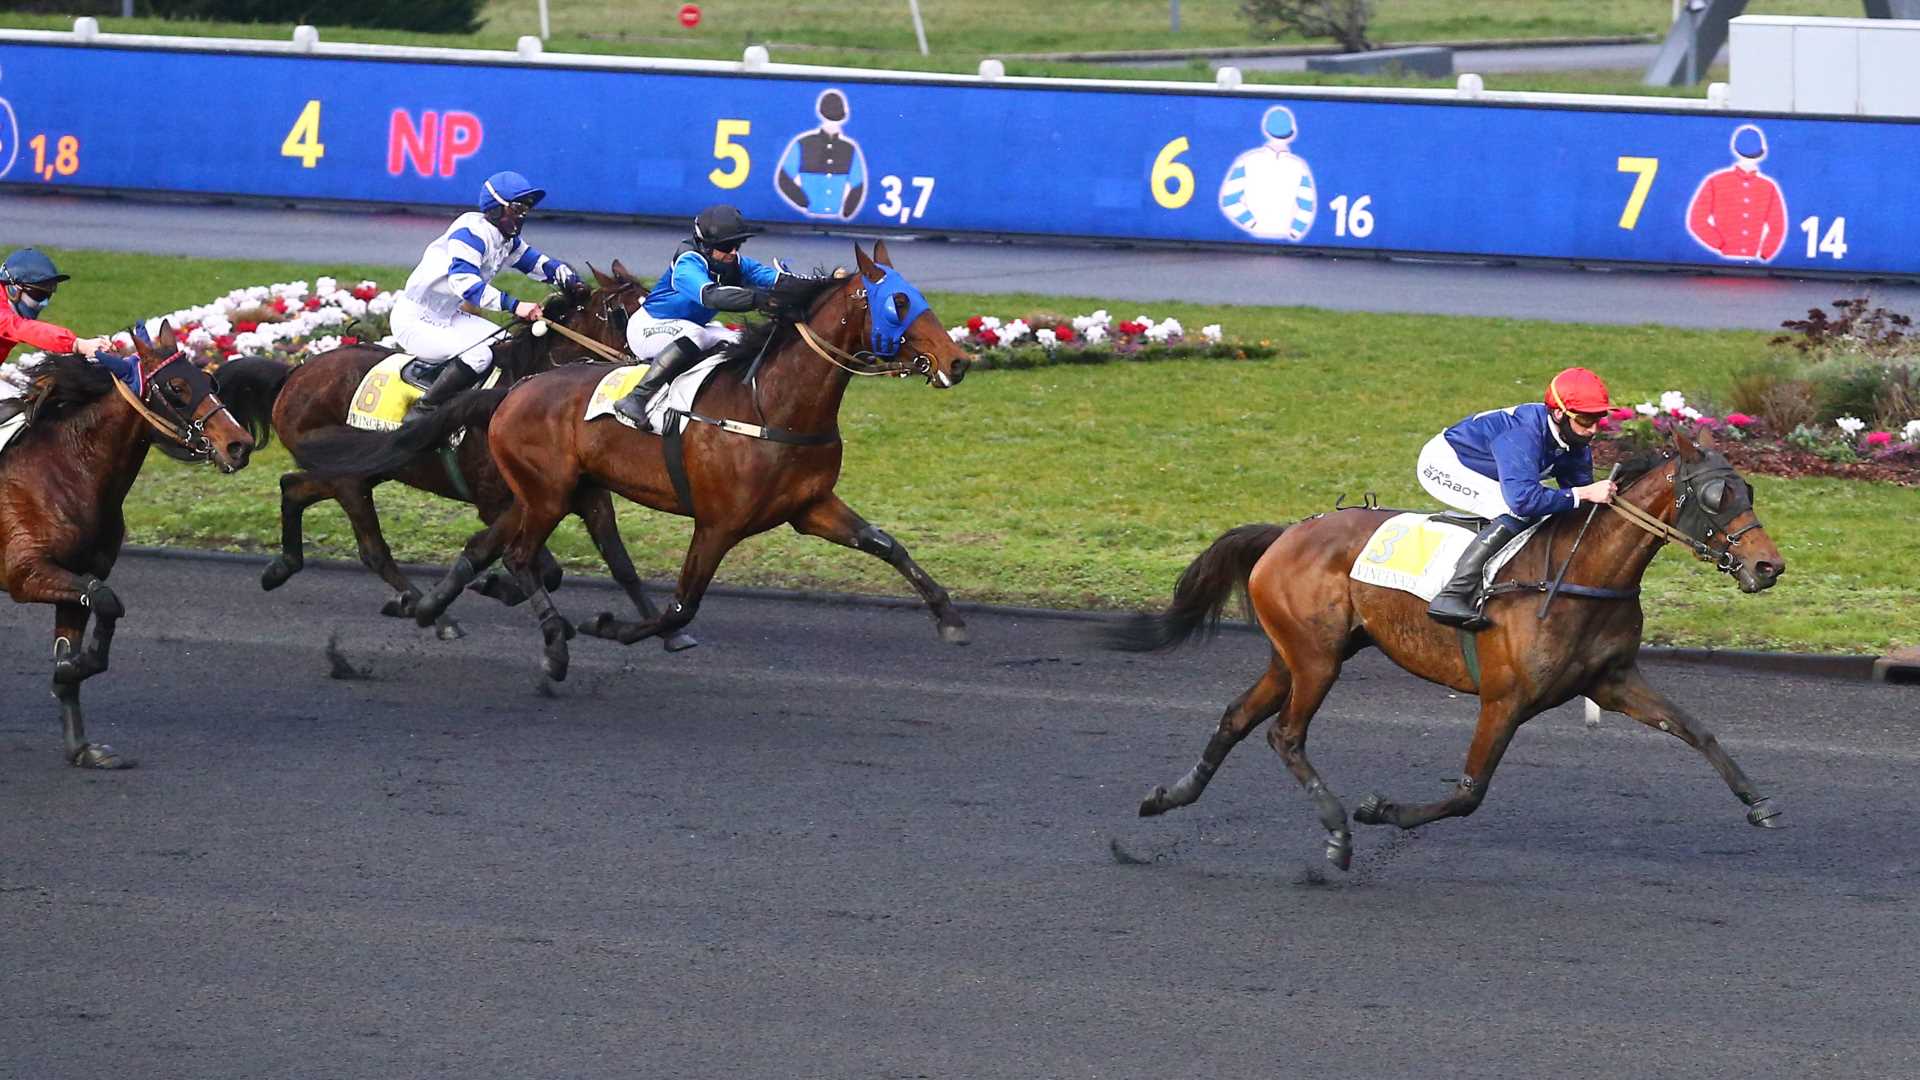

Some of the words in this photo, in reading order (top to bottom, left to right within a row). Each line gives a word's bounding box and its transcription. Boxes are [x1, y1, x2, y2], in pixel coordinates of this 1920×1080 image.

[29, 133, 80, 181] 1,8
[281, 100, 325, 169] 4
[386, 108, 484, 178] NP
[709, 119, 751, 190] 5
[1150, 136, 1195, 209] 6
[1617, 157, 1659, 230] 7
[877, 175, 935, 224] 3,7
[1329, 194, 1375, 238] 16
[1800, 215, 1848, 260] 14
[356, 373, 389, 414] 6
[1423, 467, 1480, 499] BARBOT
[1368, 524, 1408, 564] 3
